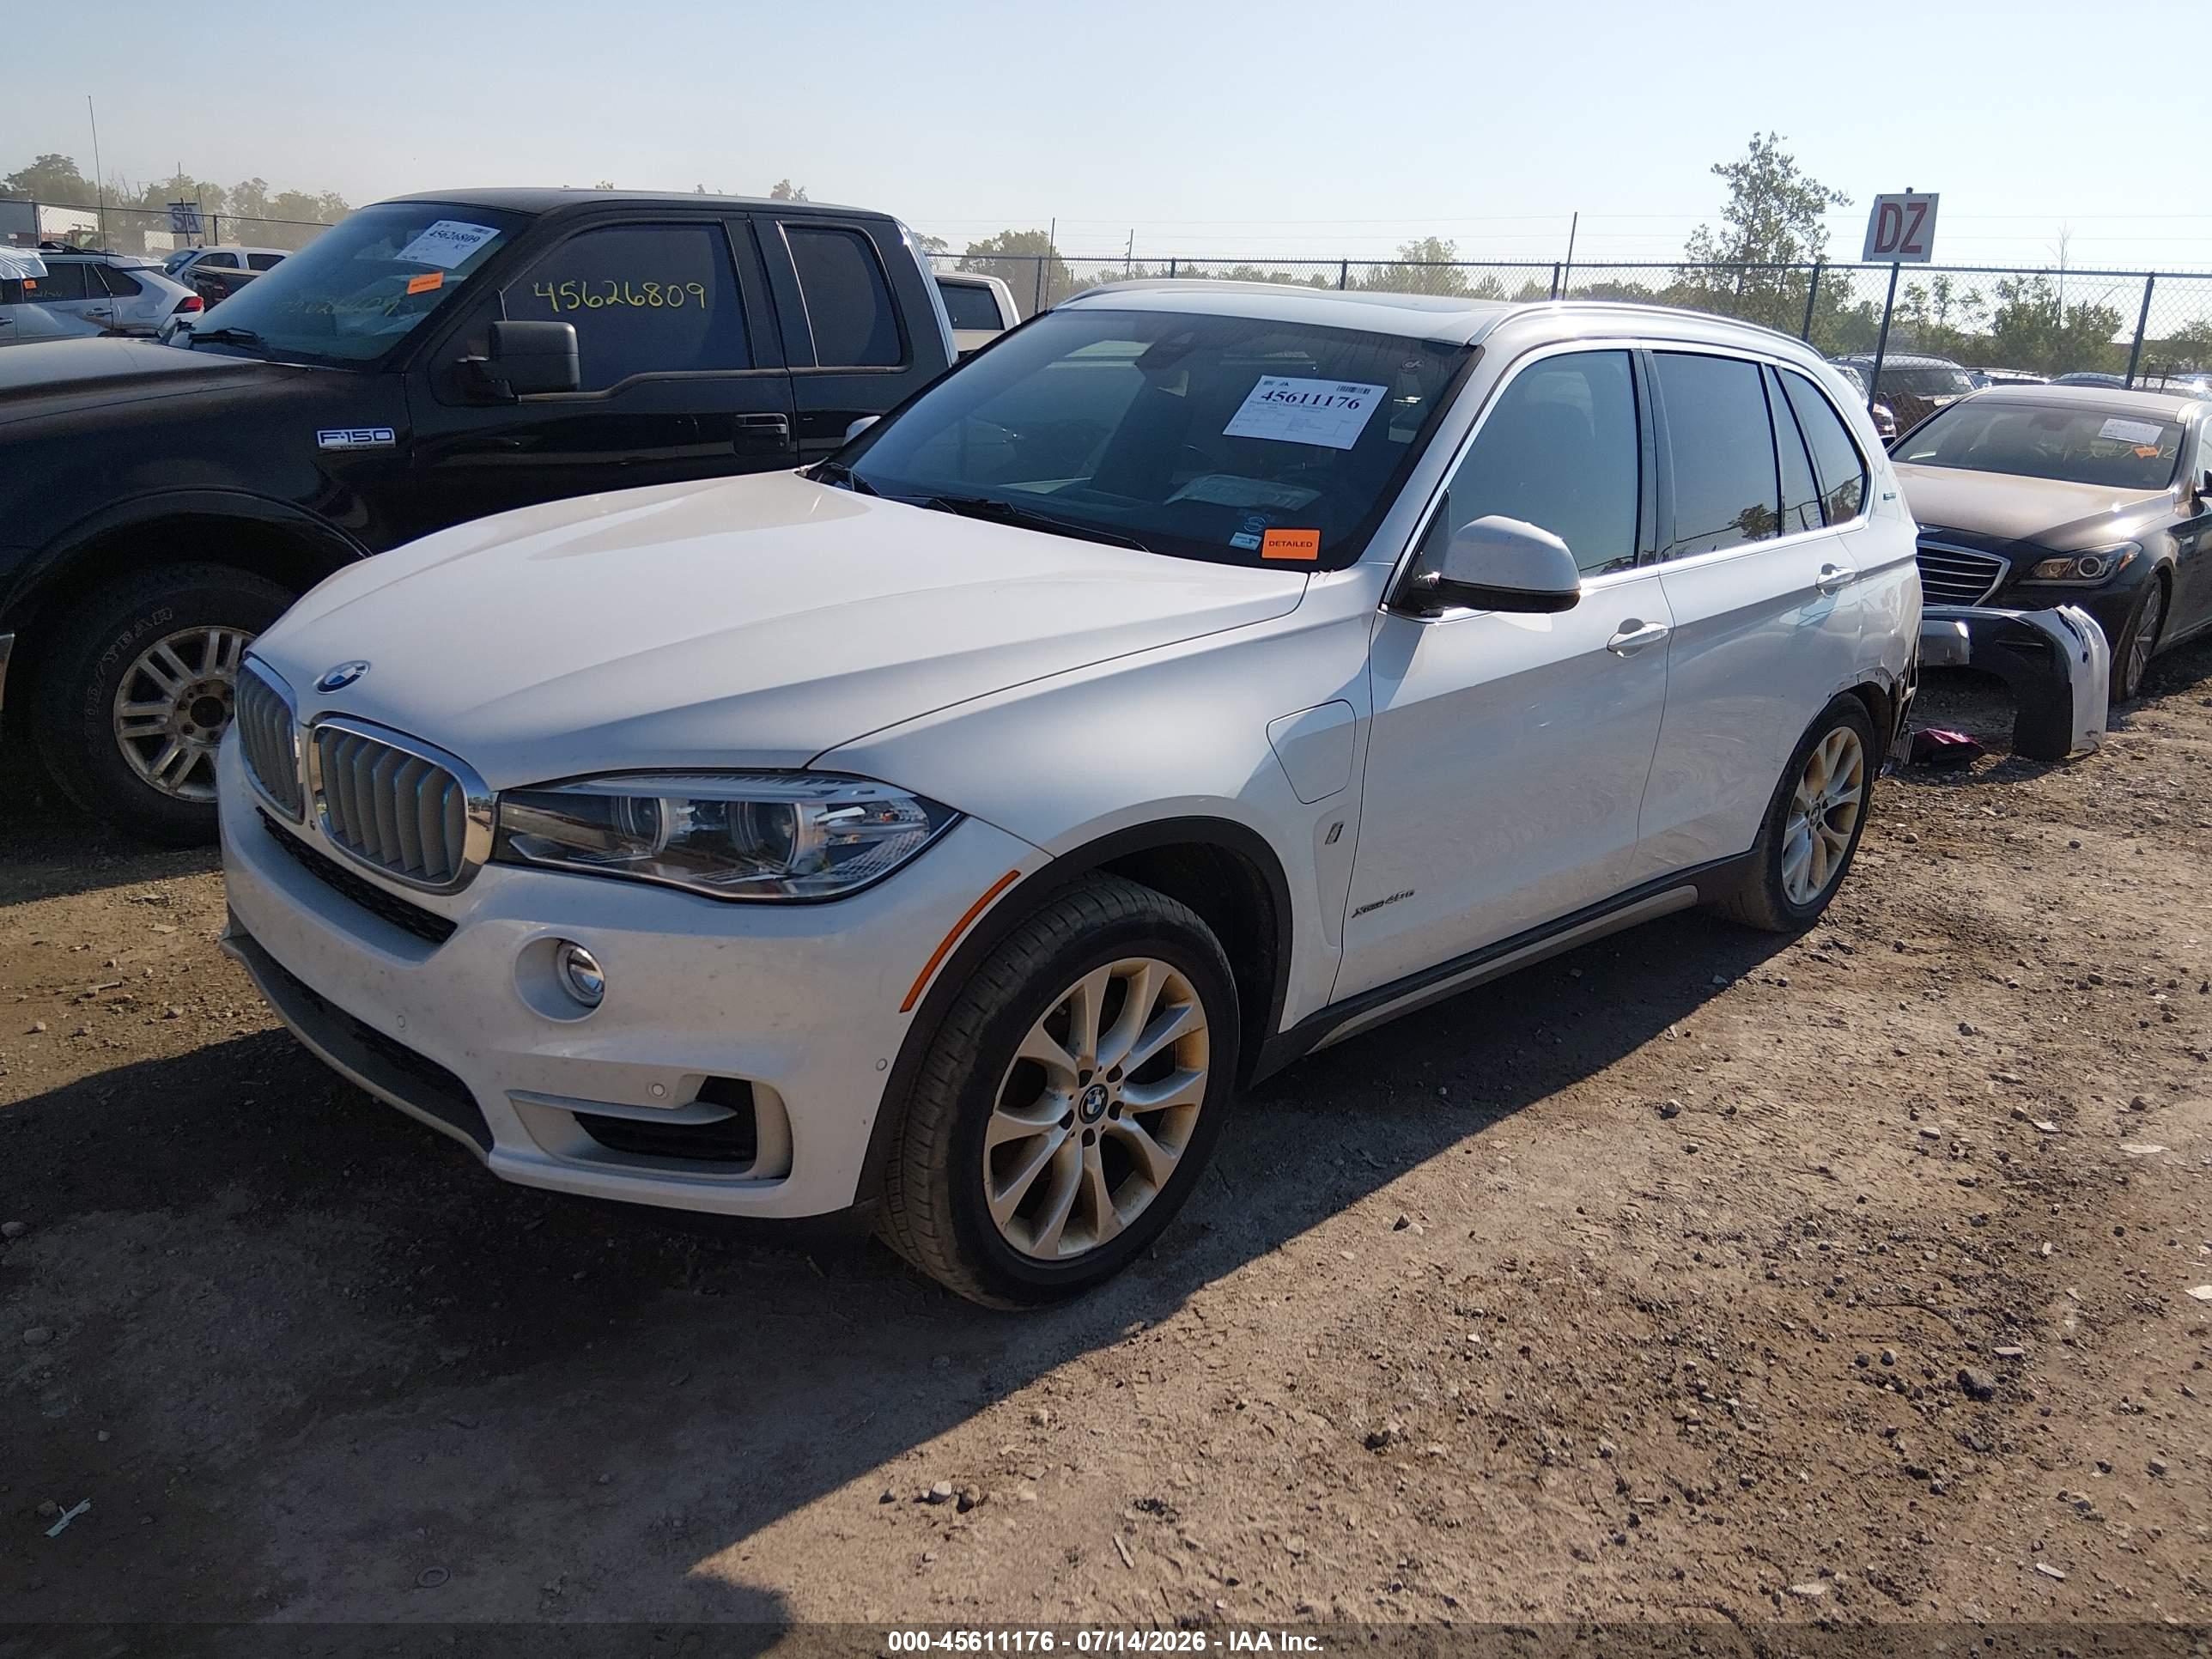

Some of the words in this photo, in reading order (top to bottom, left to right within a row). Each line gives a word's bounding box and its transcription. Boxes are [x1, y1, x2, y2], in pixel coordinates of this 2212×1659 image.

[1874, 202, 1928, 254] DZ
[532, 280, 706, 313] 45626809
[1261, 389, 1365, 410] 45611176
